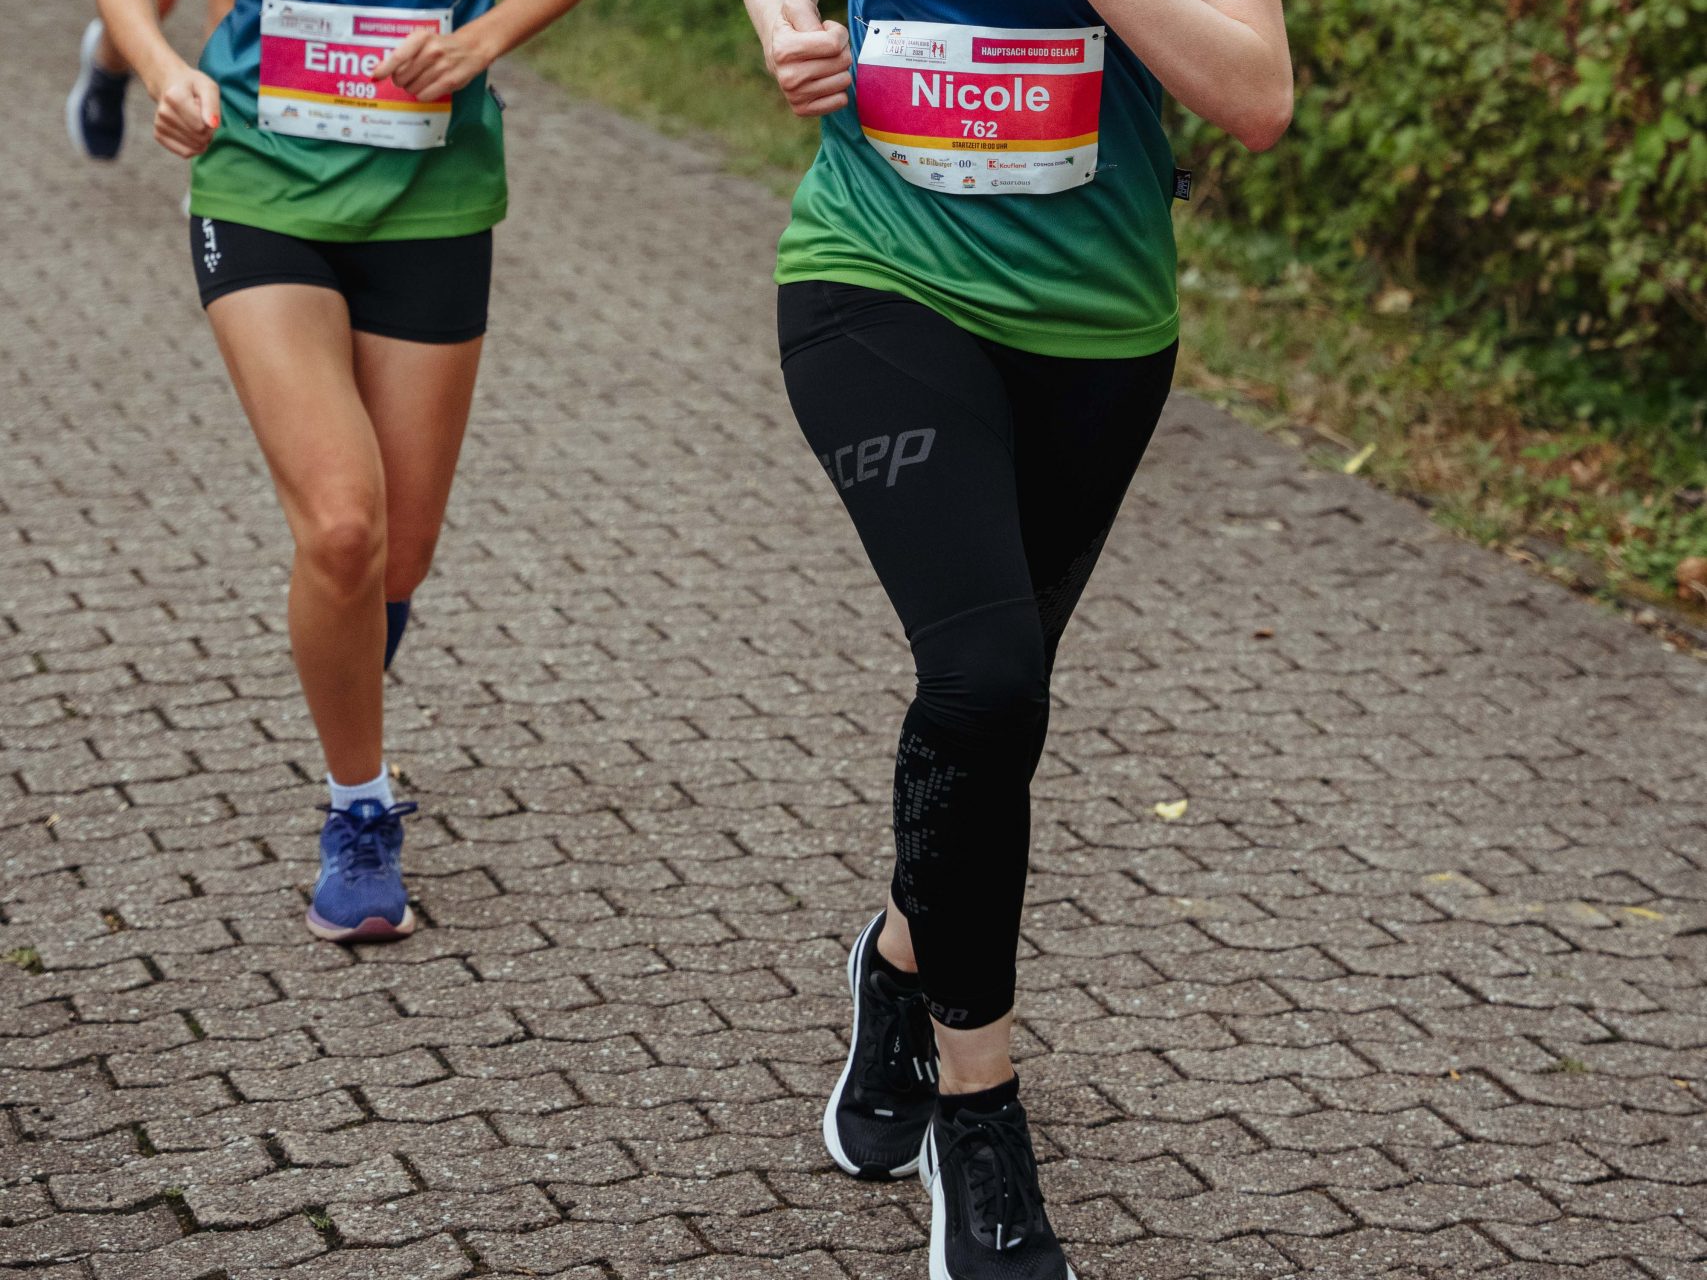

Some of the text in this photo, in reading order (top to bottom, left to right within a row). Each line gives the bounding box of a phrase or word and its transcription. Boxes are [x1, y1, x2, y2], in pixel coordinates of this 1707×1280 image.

[981, 46, 1079, 57] HAUPTSACH GUDD GELAAF
[336, 80, 377, 99] 1309
[911, 72, 1050, 112] Nicole
[961, 120, 998, 138] 762
[952, 141, 980, 149] STARTZEIT
